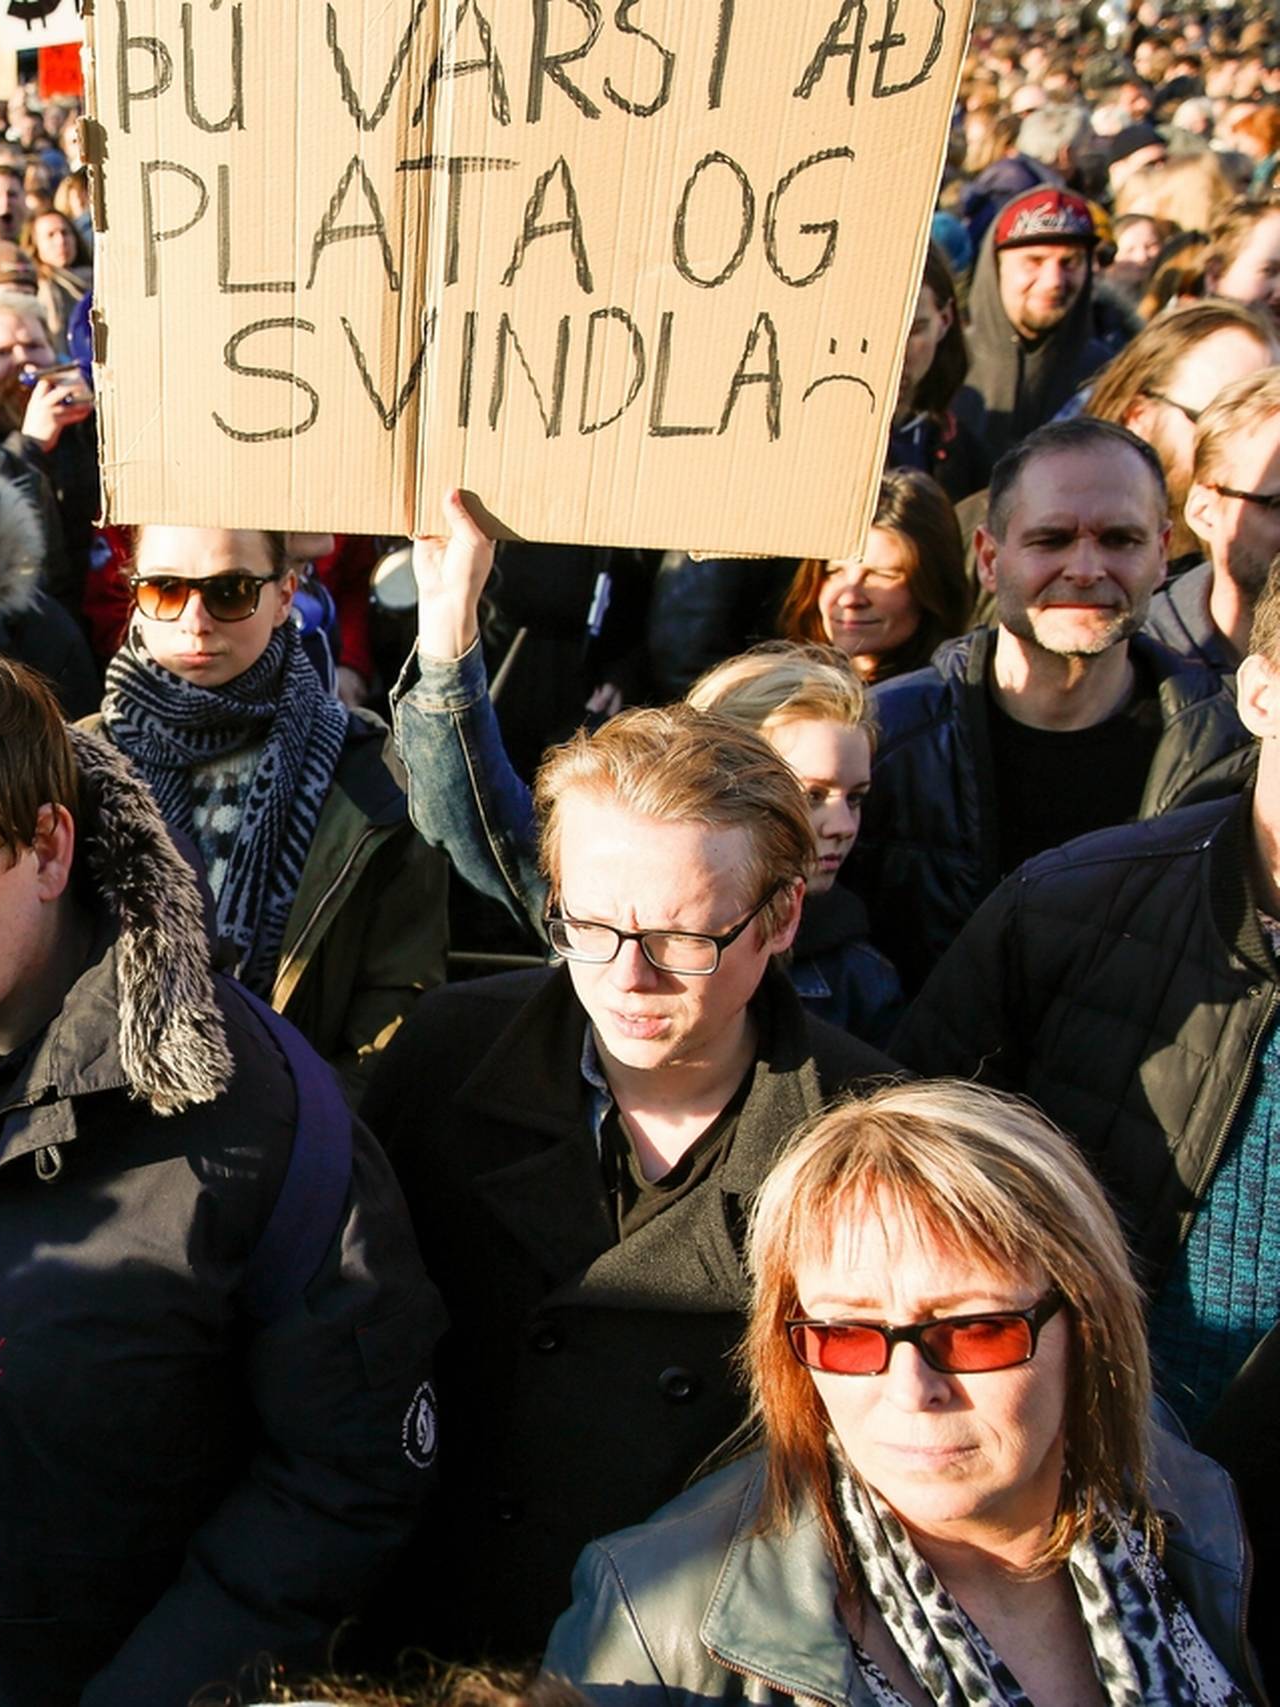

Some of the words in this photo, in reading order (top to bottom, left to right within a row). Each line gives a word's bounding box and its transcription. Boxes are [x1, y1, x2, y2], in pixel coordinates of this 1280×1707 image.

[792, 0, 946, 107] AÐ
[140, 153, 594, 296] PLATA
[672, 145, 856, 289] OG
[211, 306, 782, 443] SVINDLA
